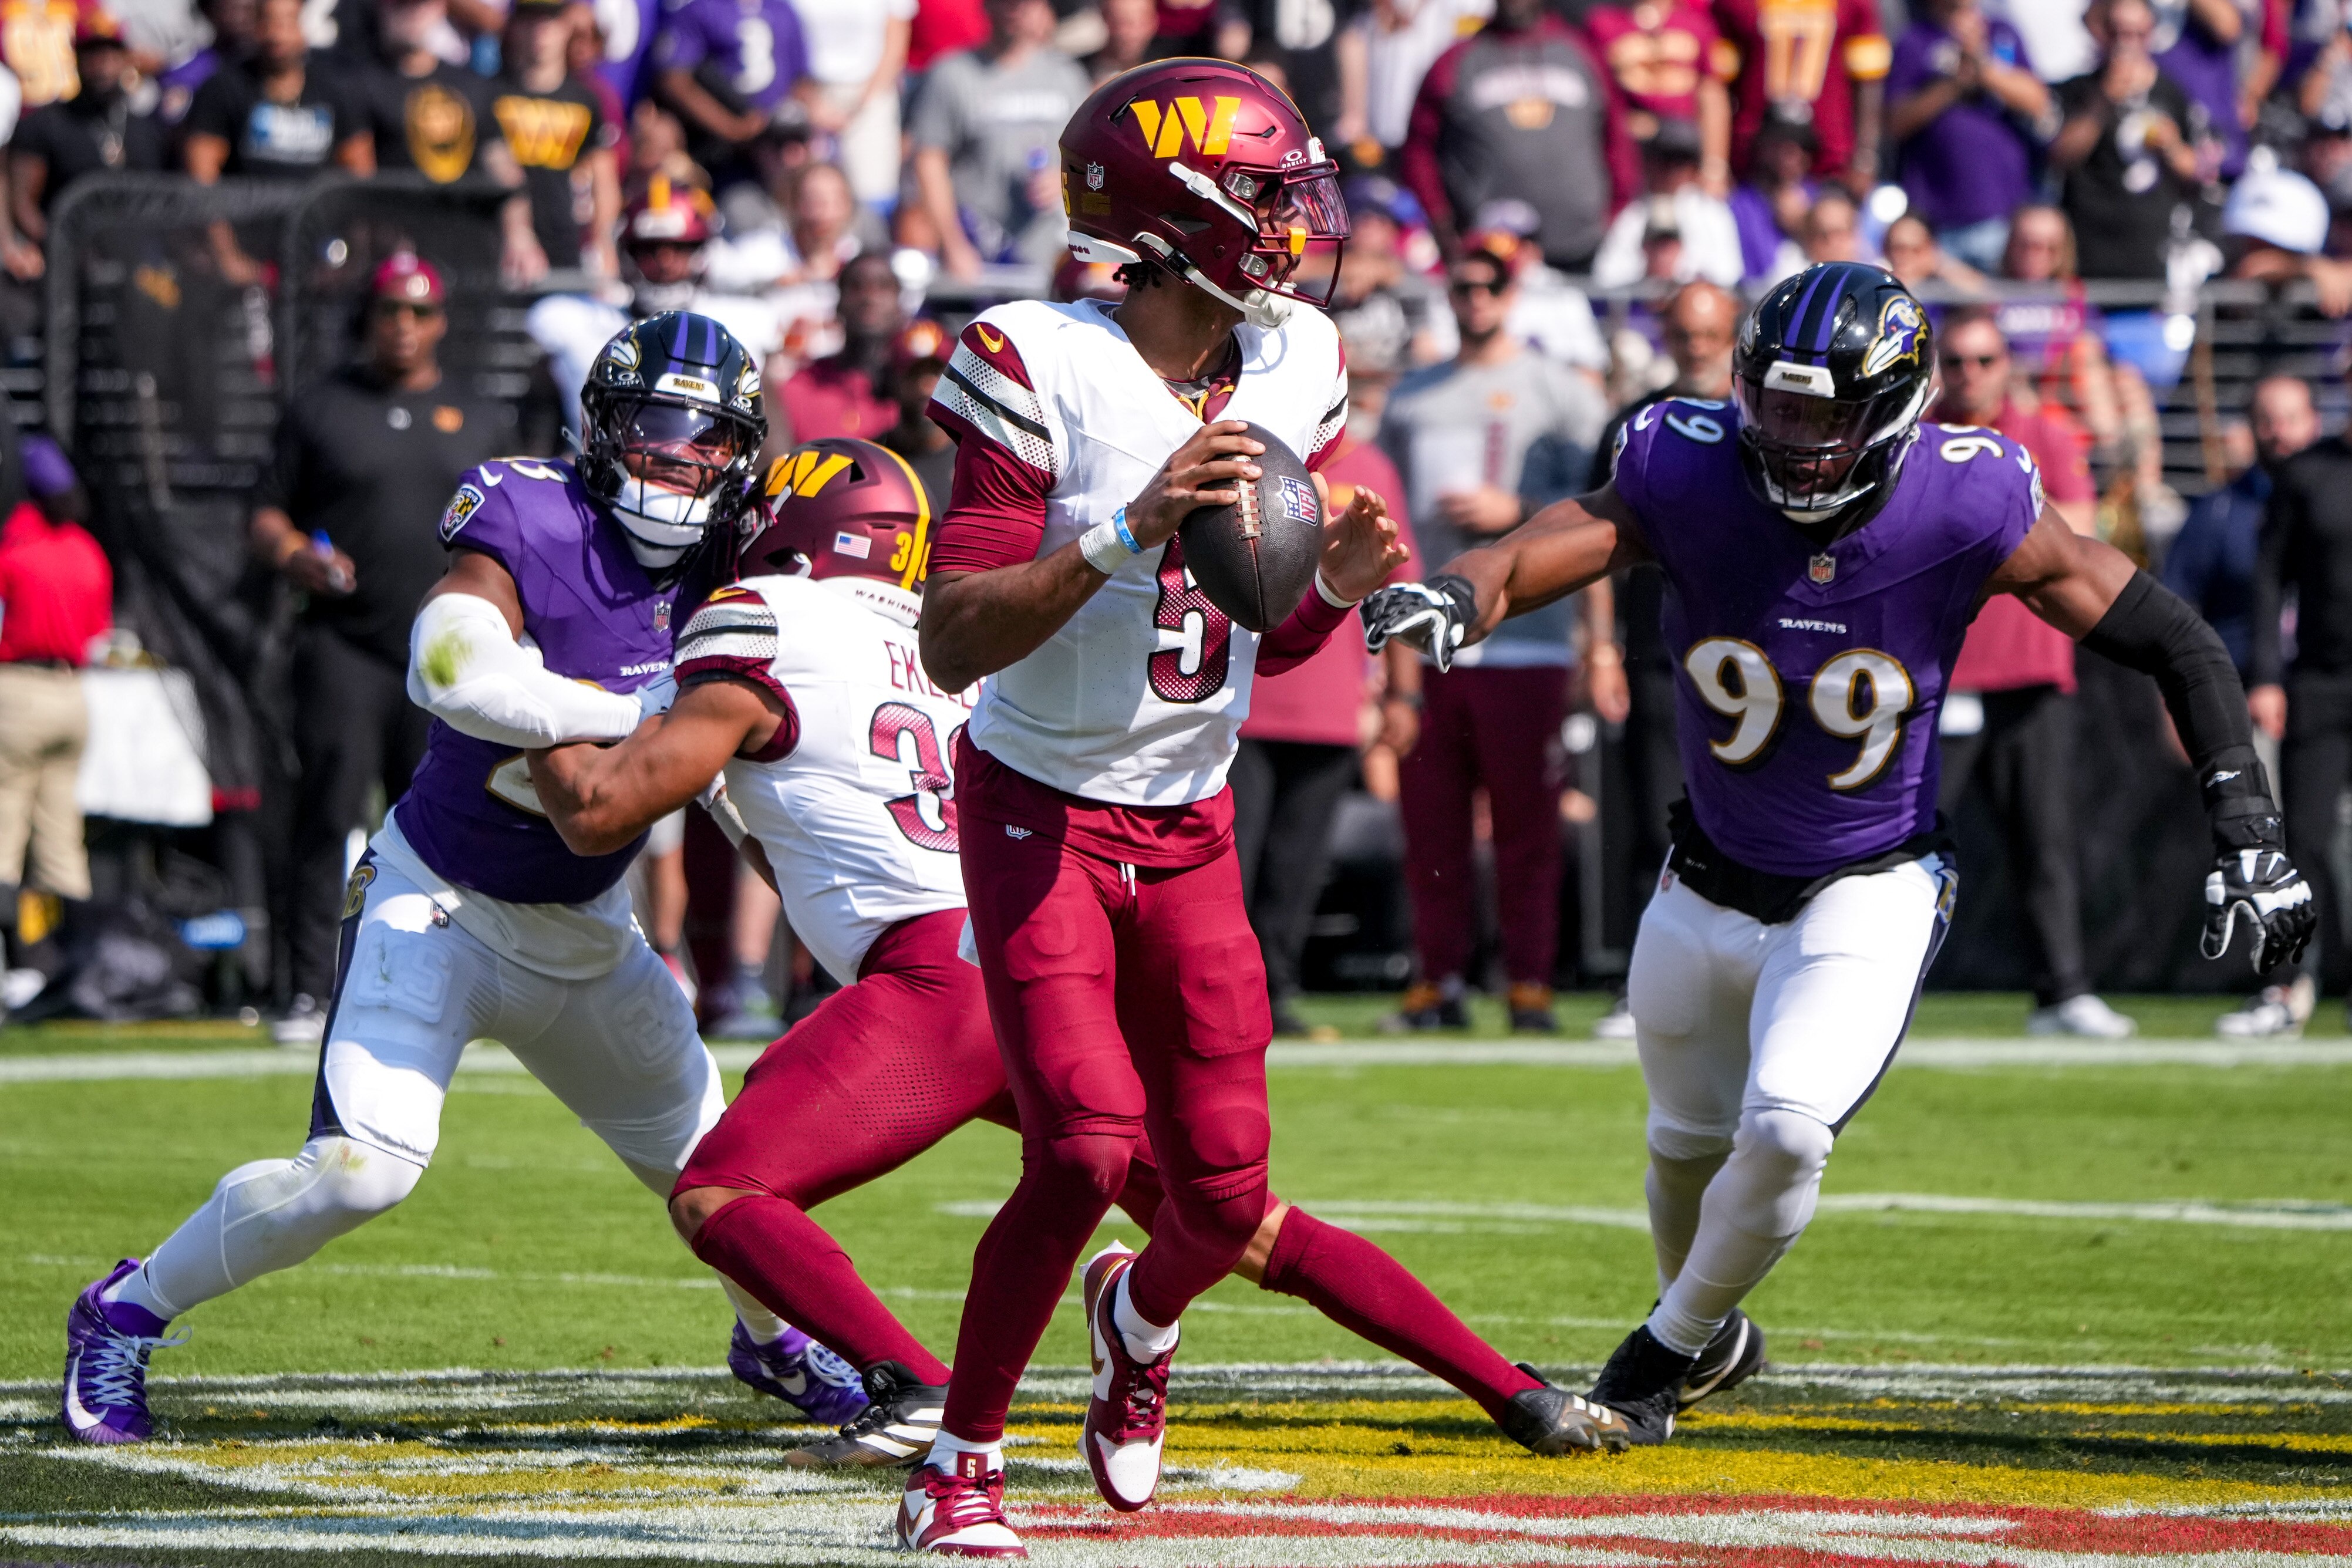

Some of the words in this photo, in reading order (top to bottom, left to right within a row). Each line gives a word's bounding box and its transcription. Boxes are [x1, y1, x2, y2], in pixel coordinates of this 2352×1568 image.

[1281, 157, 1308, 168] OAKLEY
[1089, 174, 1101, 186] NFL
[673, 377, 705, 392] RAVENS
[1299, 487, 1317, 521] NFL
[1778, 618, 1847, 635] RAVENS
[619, 660, 670, 676] RAVEN
[1683, 636, 1915, 790] 99
[966, 1458, 977, 1479] 5
